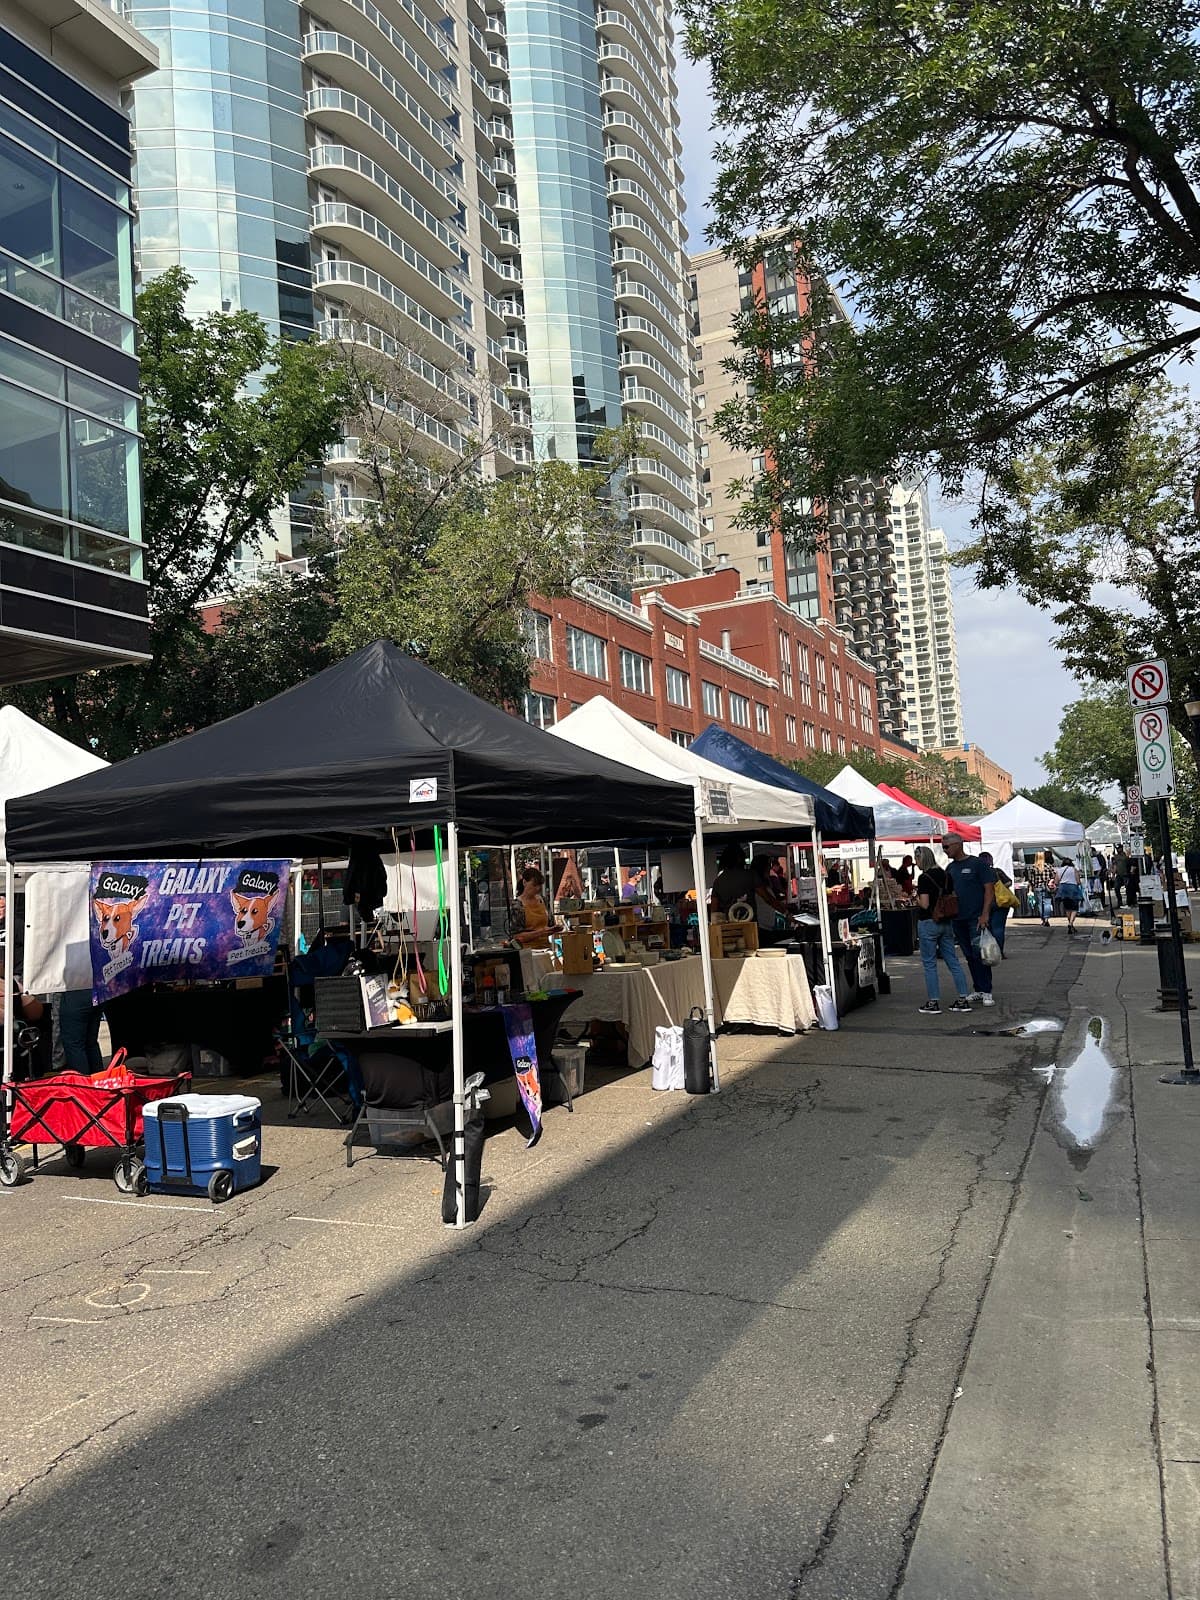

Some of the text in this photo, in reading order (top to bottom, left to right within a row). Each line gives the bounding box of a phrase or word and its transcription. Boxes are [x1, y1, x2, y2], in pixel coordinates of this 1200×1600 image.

[102, 876, 144, 900] Galaxy
[158, 866, 232, 895] GALAXY
[242, 873, 277, 894] Galaxy
[163, 902, 203, 930] PET
[139, 937, 207, 969] TREATS
[230, 945, 268, 960] Pet Treats
